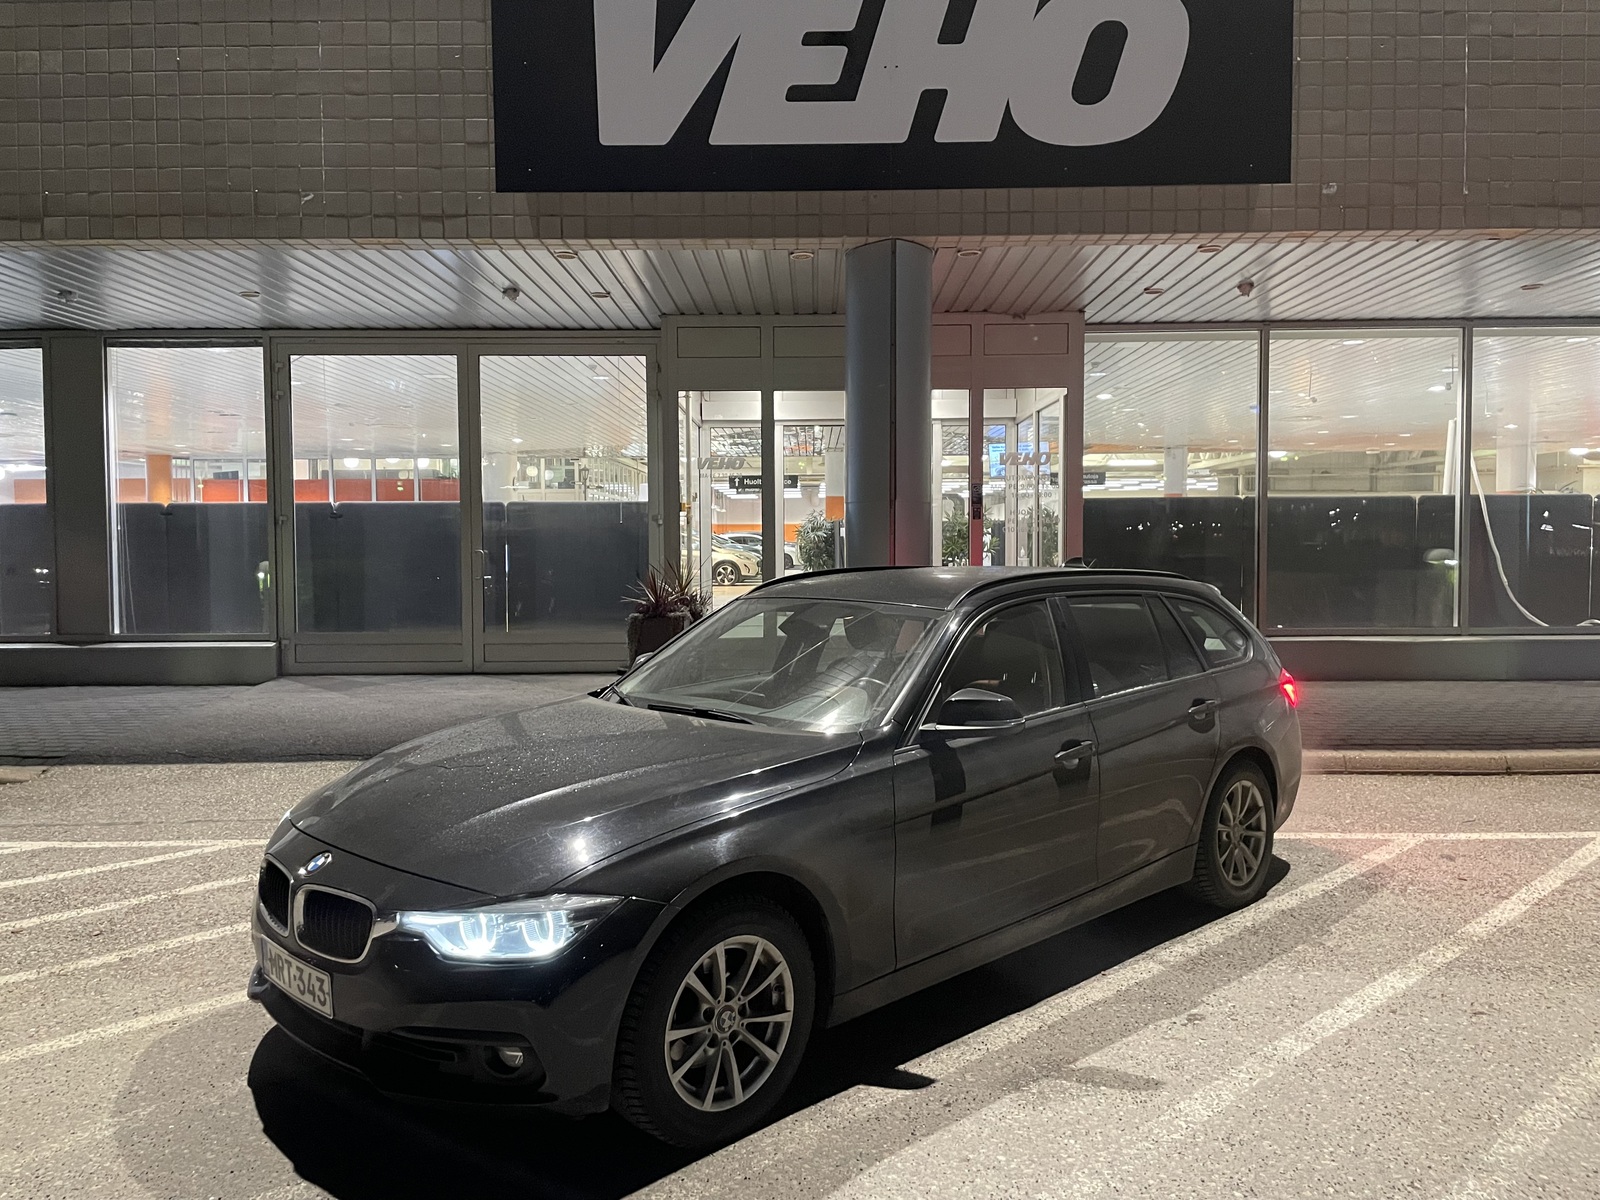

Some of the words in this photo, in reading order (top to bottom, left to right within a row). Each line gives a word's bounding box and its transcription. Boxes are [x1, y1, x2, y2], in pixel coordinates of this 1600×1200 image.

[594, 0, 1190, 147] VEHO
[697, 457, 745, 470] VEHO
[1000, 452, 1050, 465] VEHO
